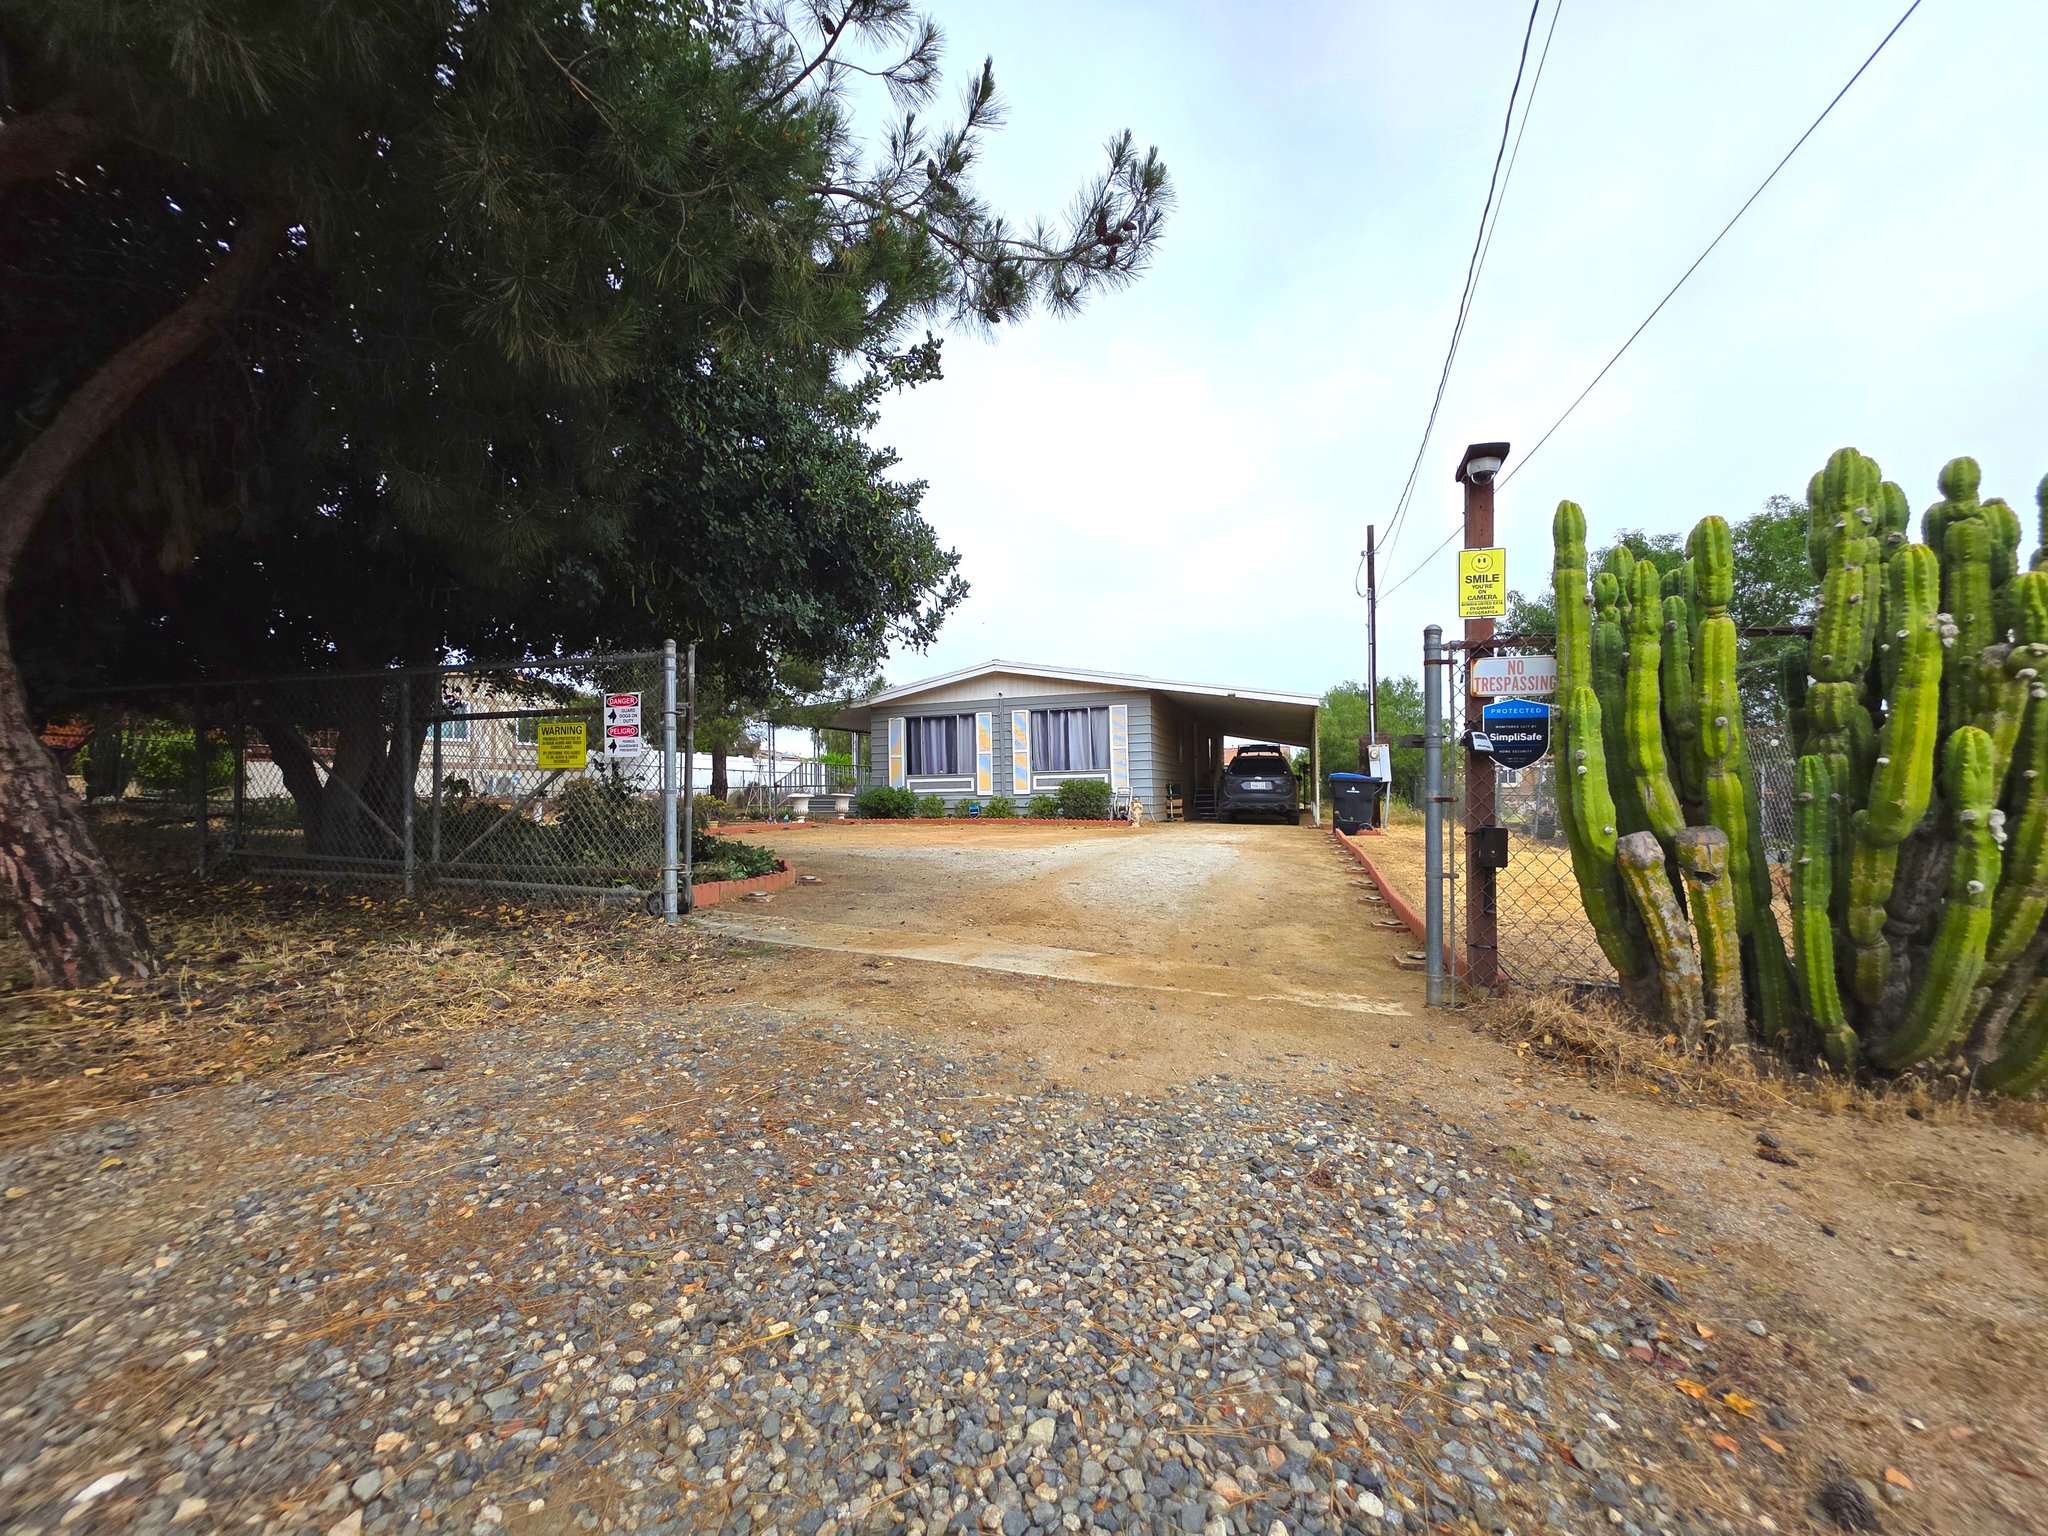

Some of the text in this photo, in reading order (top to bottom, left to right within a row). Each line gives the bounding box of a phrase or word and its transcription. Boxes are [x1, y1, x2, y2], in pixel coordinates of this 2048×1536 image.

[1465, 574, 1500, 584] SMILE
[1508, 660, 1524, 675] NO
[1474, 675, 1556, 692] TRESPASSING
[541, 725, 583, 736] WARNING
[1490, 733, 1542, 742] SimpliSafe
